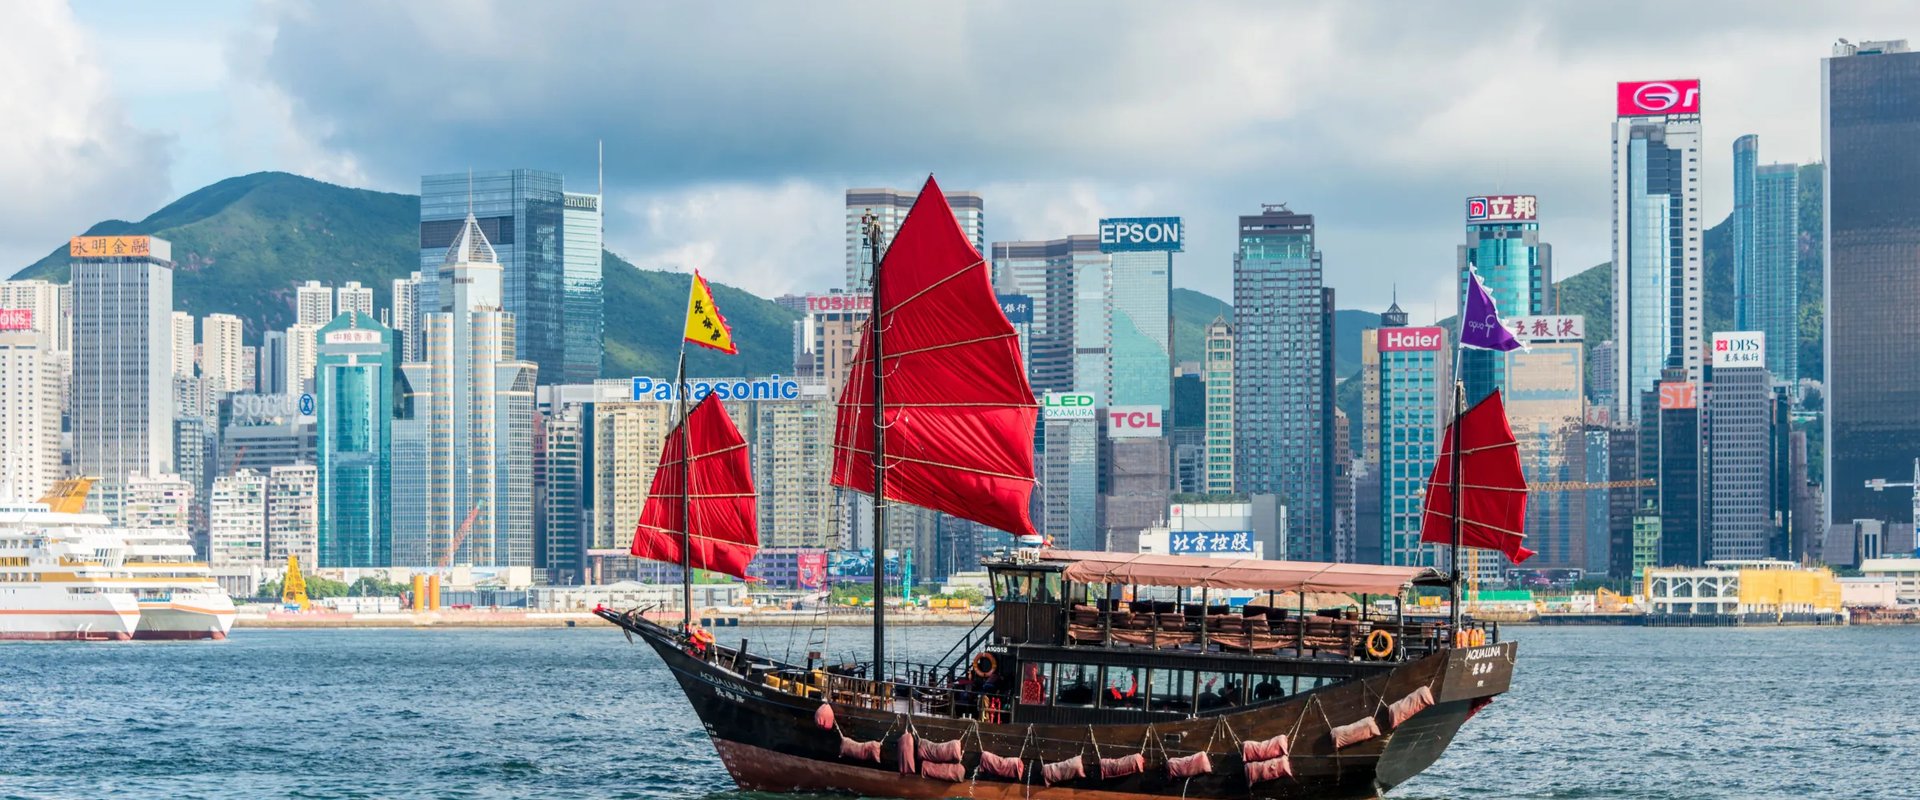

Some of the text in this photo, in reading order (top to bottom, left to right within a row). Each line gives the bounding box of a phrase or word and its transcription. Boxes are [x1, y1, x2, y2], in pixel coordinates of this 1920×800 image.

[1489, 196, 1536, 219] 立邦
[1101, 223, 1178, 243] EPSON
[72, 237, 149, 255] 永明金融
[1387, 331, 1440, 348] Haier
[1730, 339, 1759, 351] DBS
[632, 374, 799, 401] Panasonic
[1045, 396, 1094, 407] LED
[1045, 408, 1095, 417] OKAMURA
[1110, 412, 1160, 428] TCL
[1173, 532, 1251, 552] 北京控股
